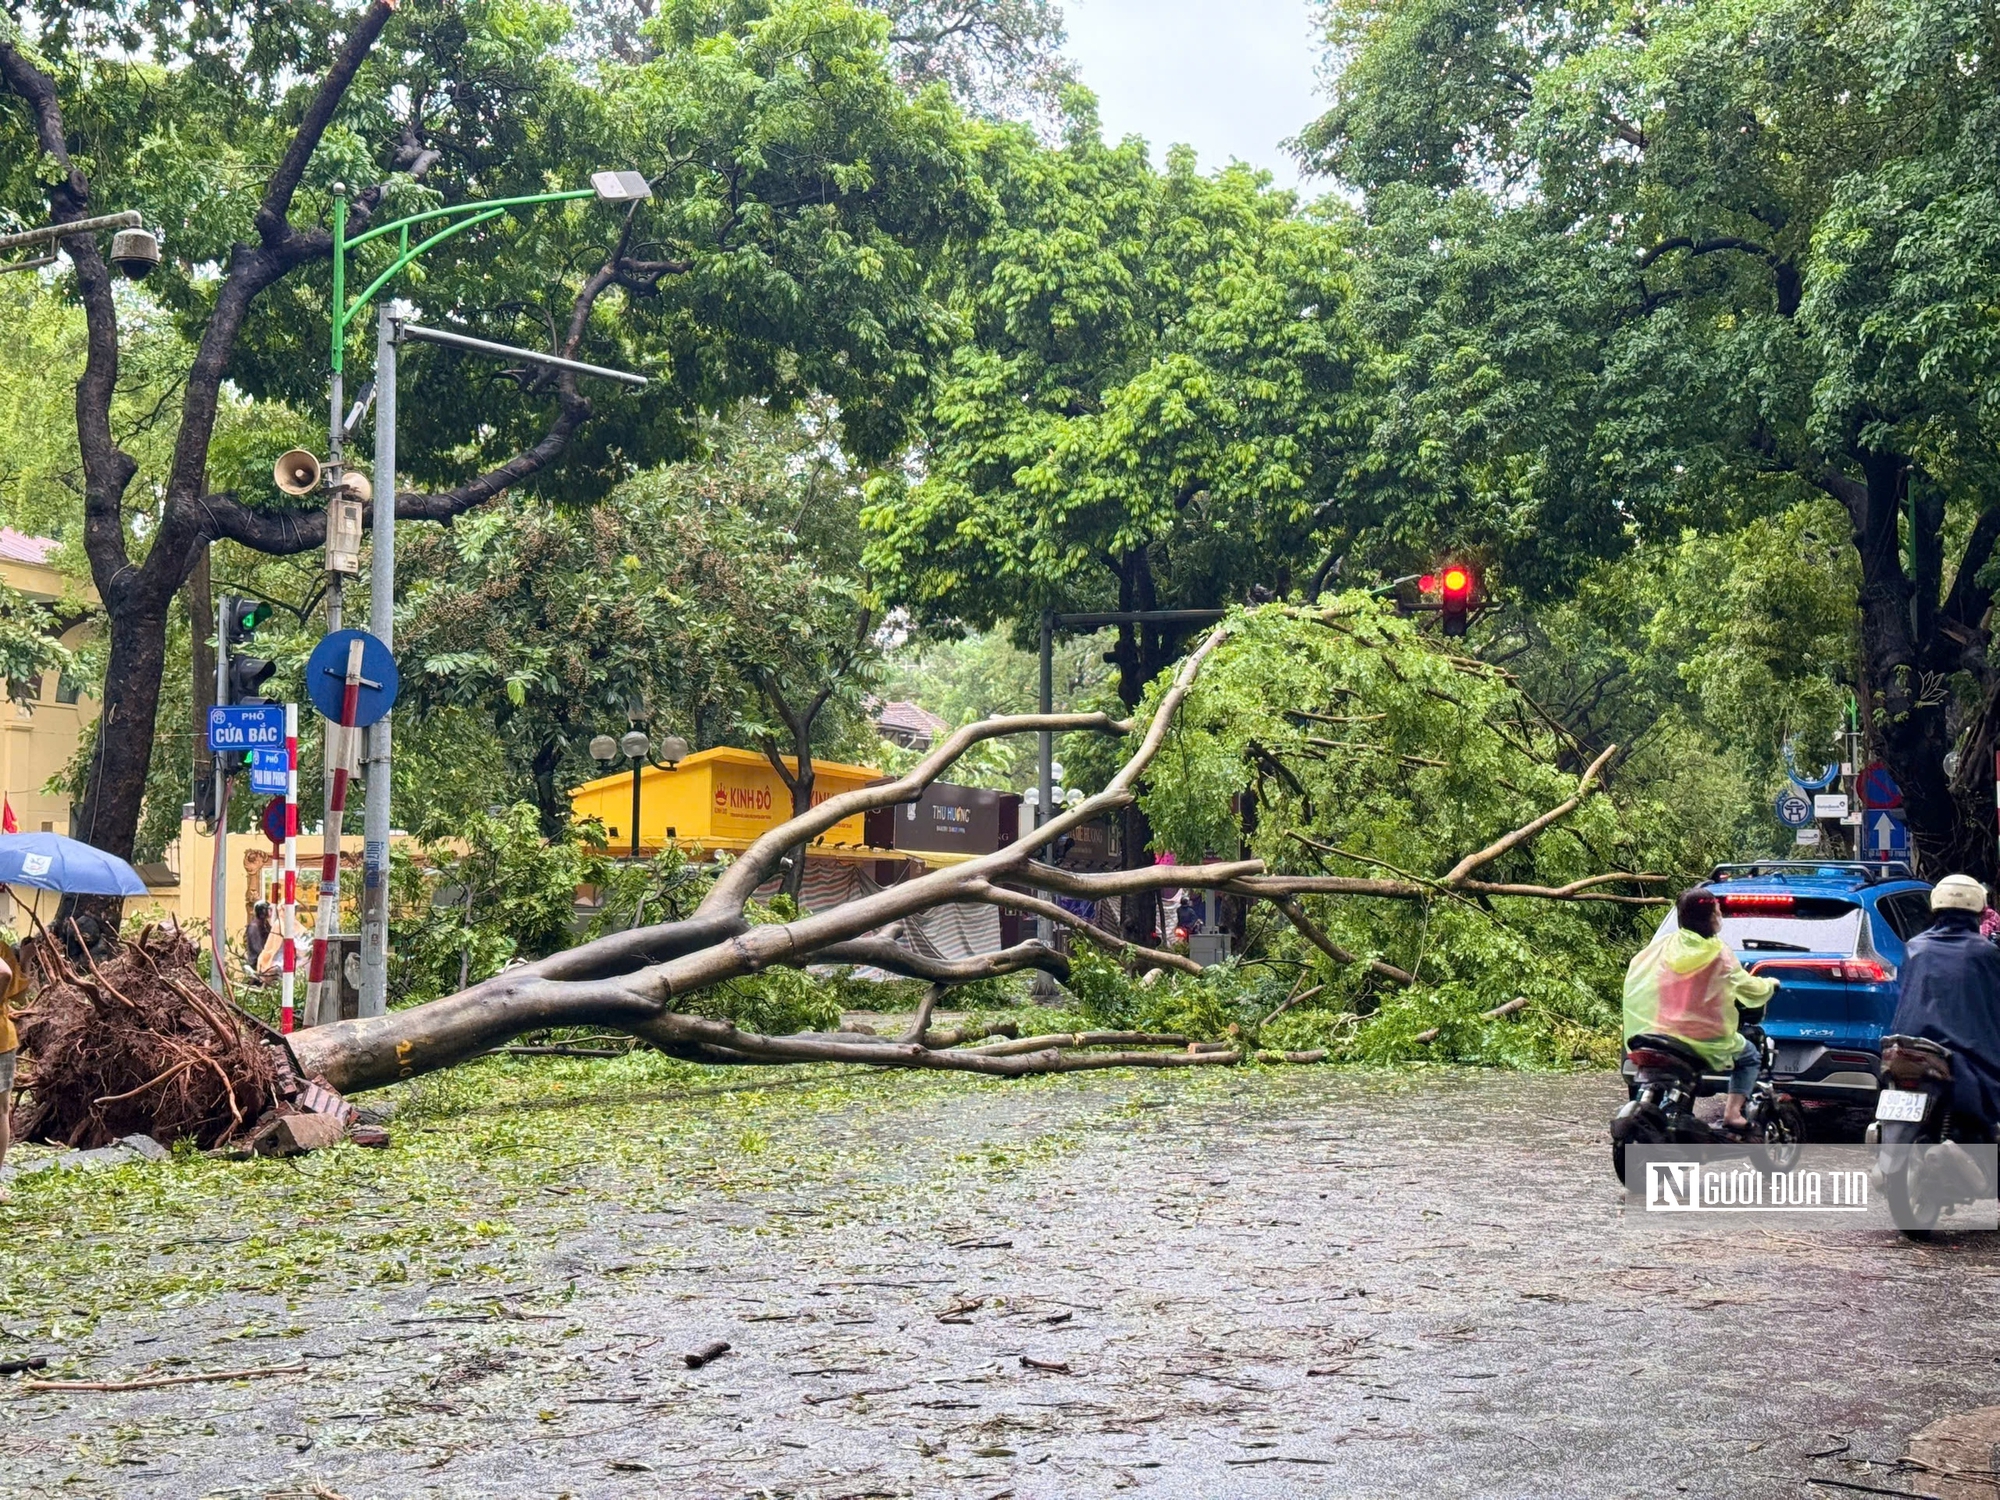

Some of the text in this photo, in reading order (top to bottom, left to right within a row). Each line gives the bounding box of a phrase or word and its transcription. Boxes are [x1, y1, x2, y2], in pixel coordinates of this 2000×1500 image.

[241, 709, 266, 721] PHỐ
[215, 722, 278, 743] CỬA BẮC
[265, 752, 279, 764] PHỐ
[730, 785, 772, 810] KINH ĐÔ
[932, 805, 946, 821] THU
